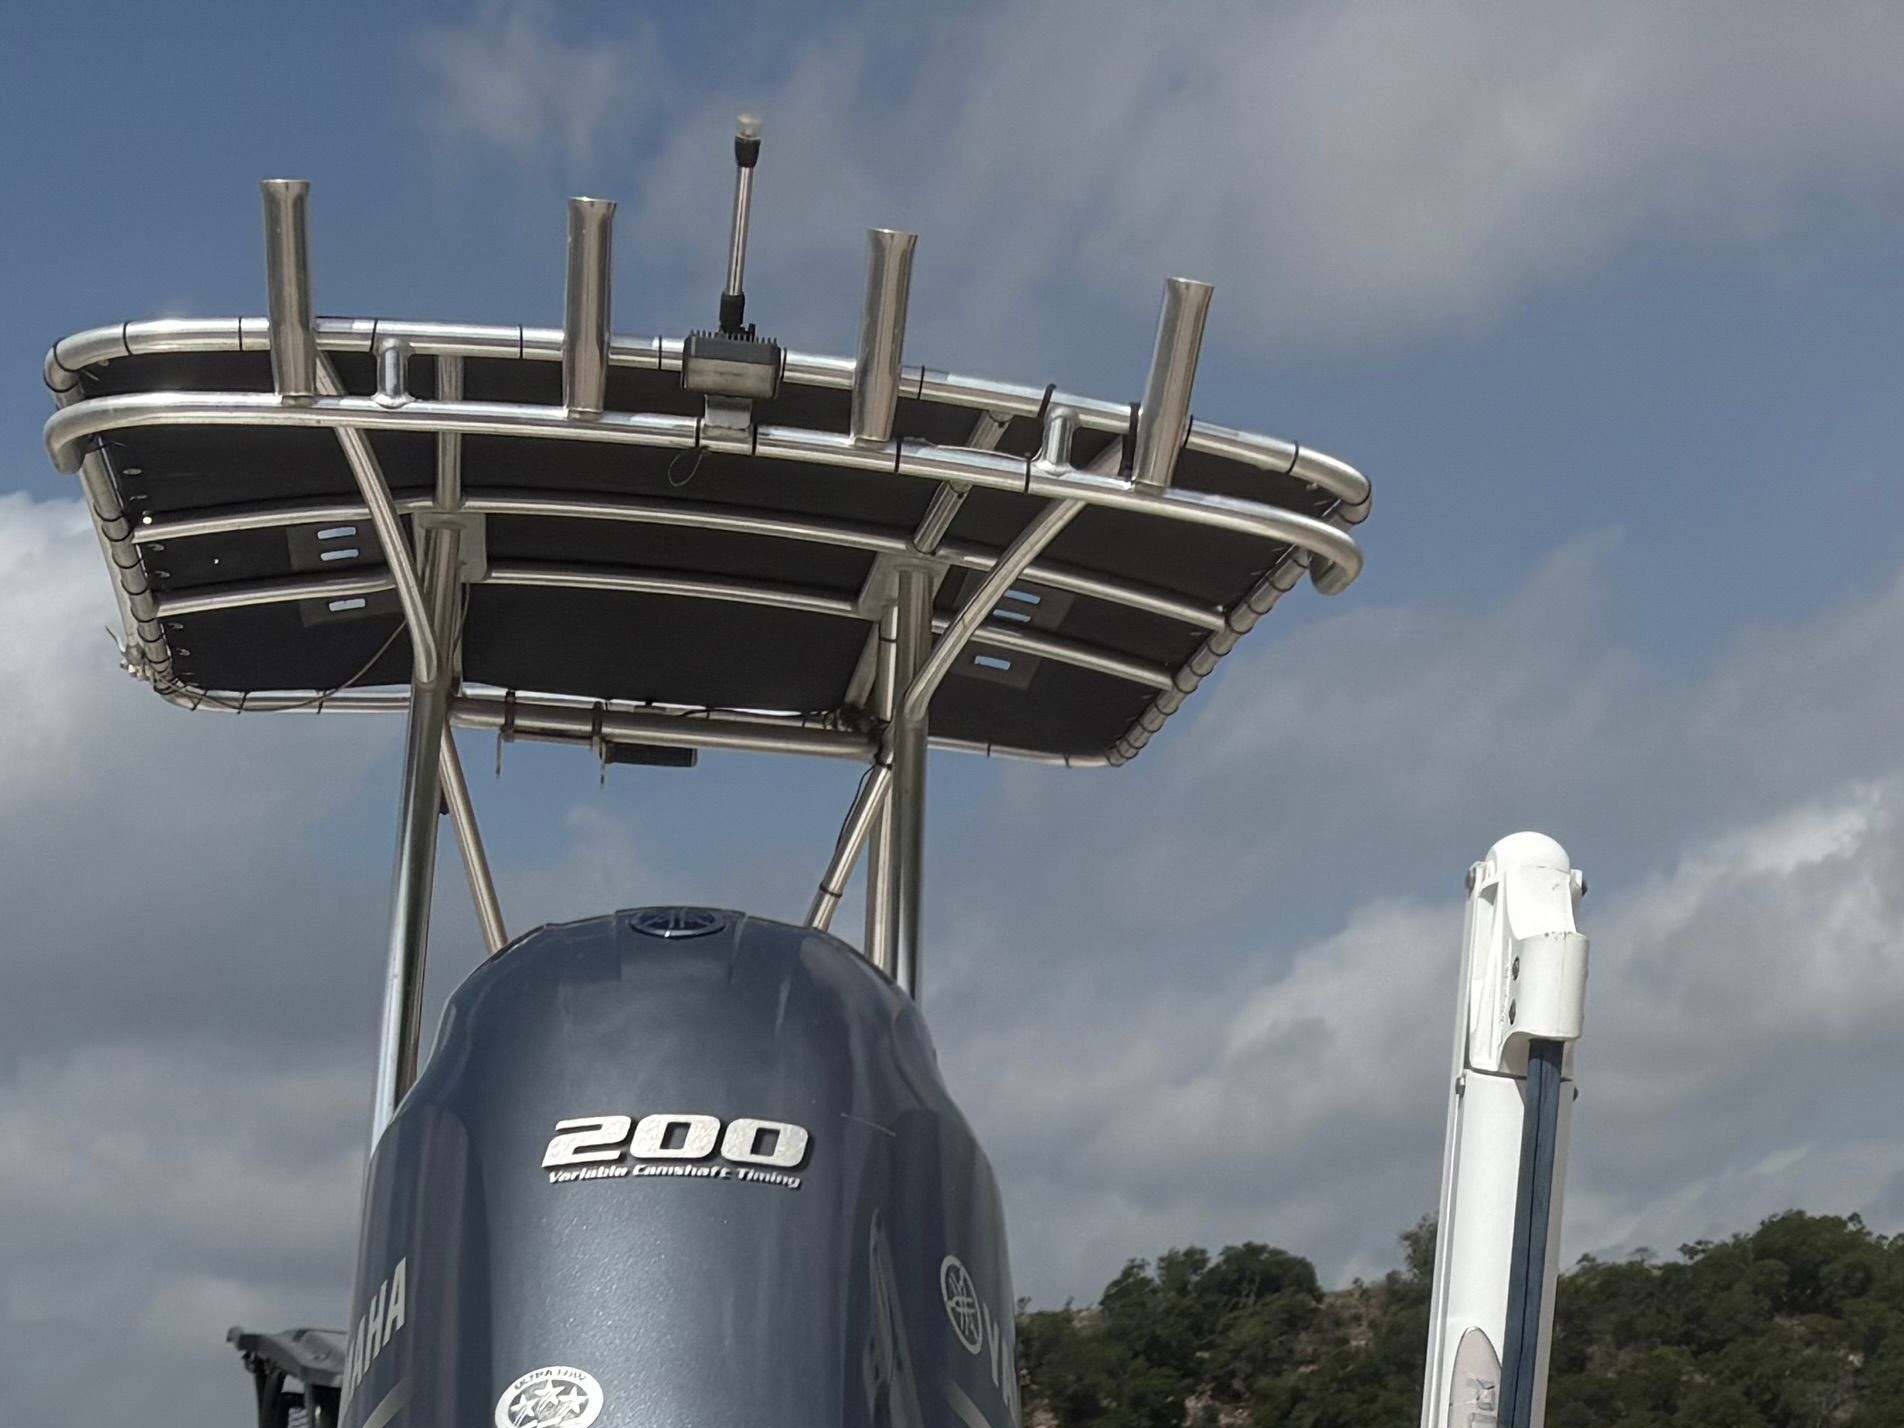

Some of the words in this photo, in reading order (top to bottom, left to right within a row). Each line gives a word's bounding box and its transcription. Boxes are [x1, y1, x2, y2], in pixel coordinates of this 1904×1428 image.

[542, 1114, 808, 1168] 200
[549, 1165, 628, 1184] Variable
[632, 1164, 732, 1179] Camshaft
[736, 1168, 801, 1188] Timing
